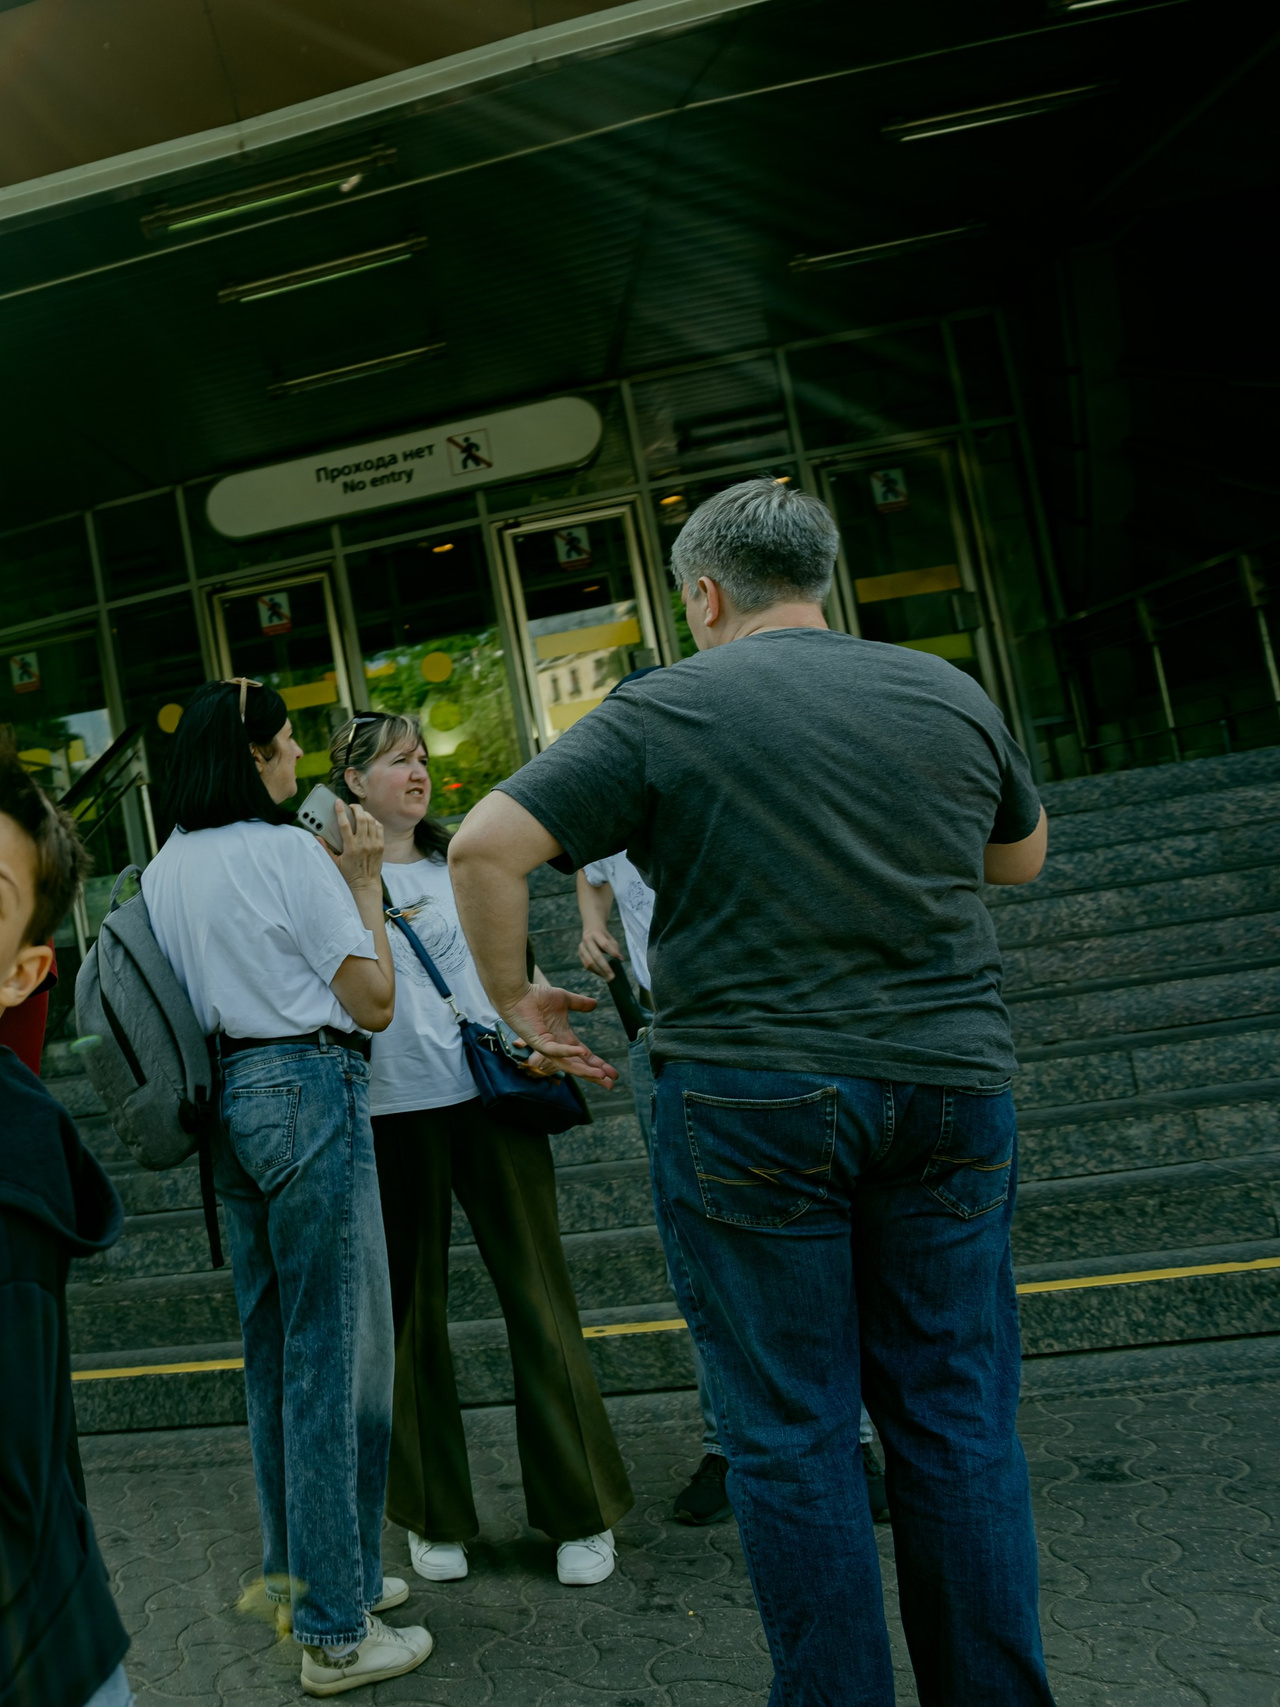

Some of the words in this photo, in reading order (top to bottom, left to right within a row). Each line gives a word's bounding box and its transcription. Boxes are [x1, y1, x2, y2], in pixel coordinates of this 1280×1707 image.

[315, 453, 399, 483] Прохода
[402, 443, 435, 462] нет
[342, 479, 367, 494] No
[369, 468, 414, 488] entry
